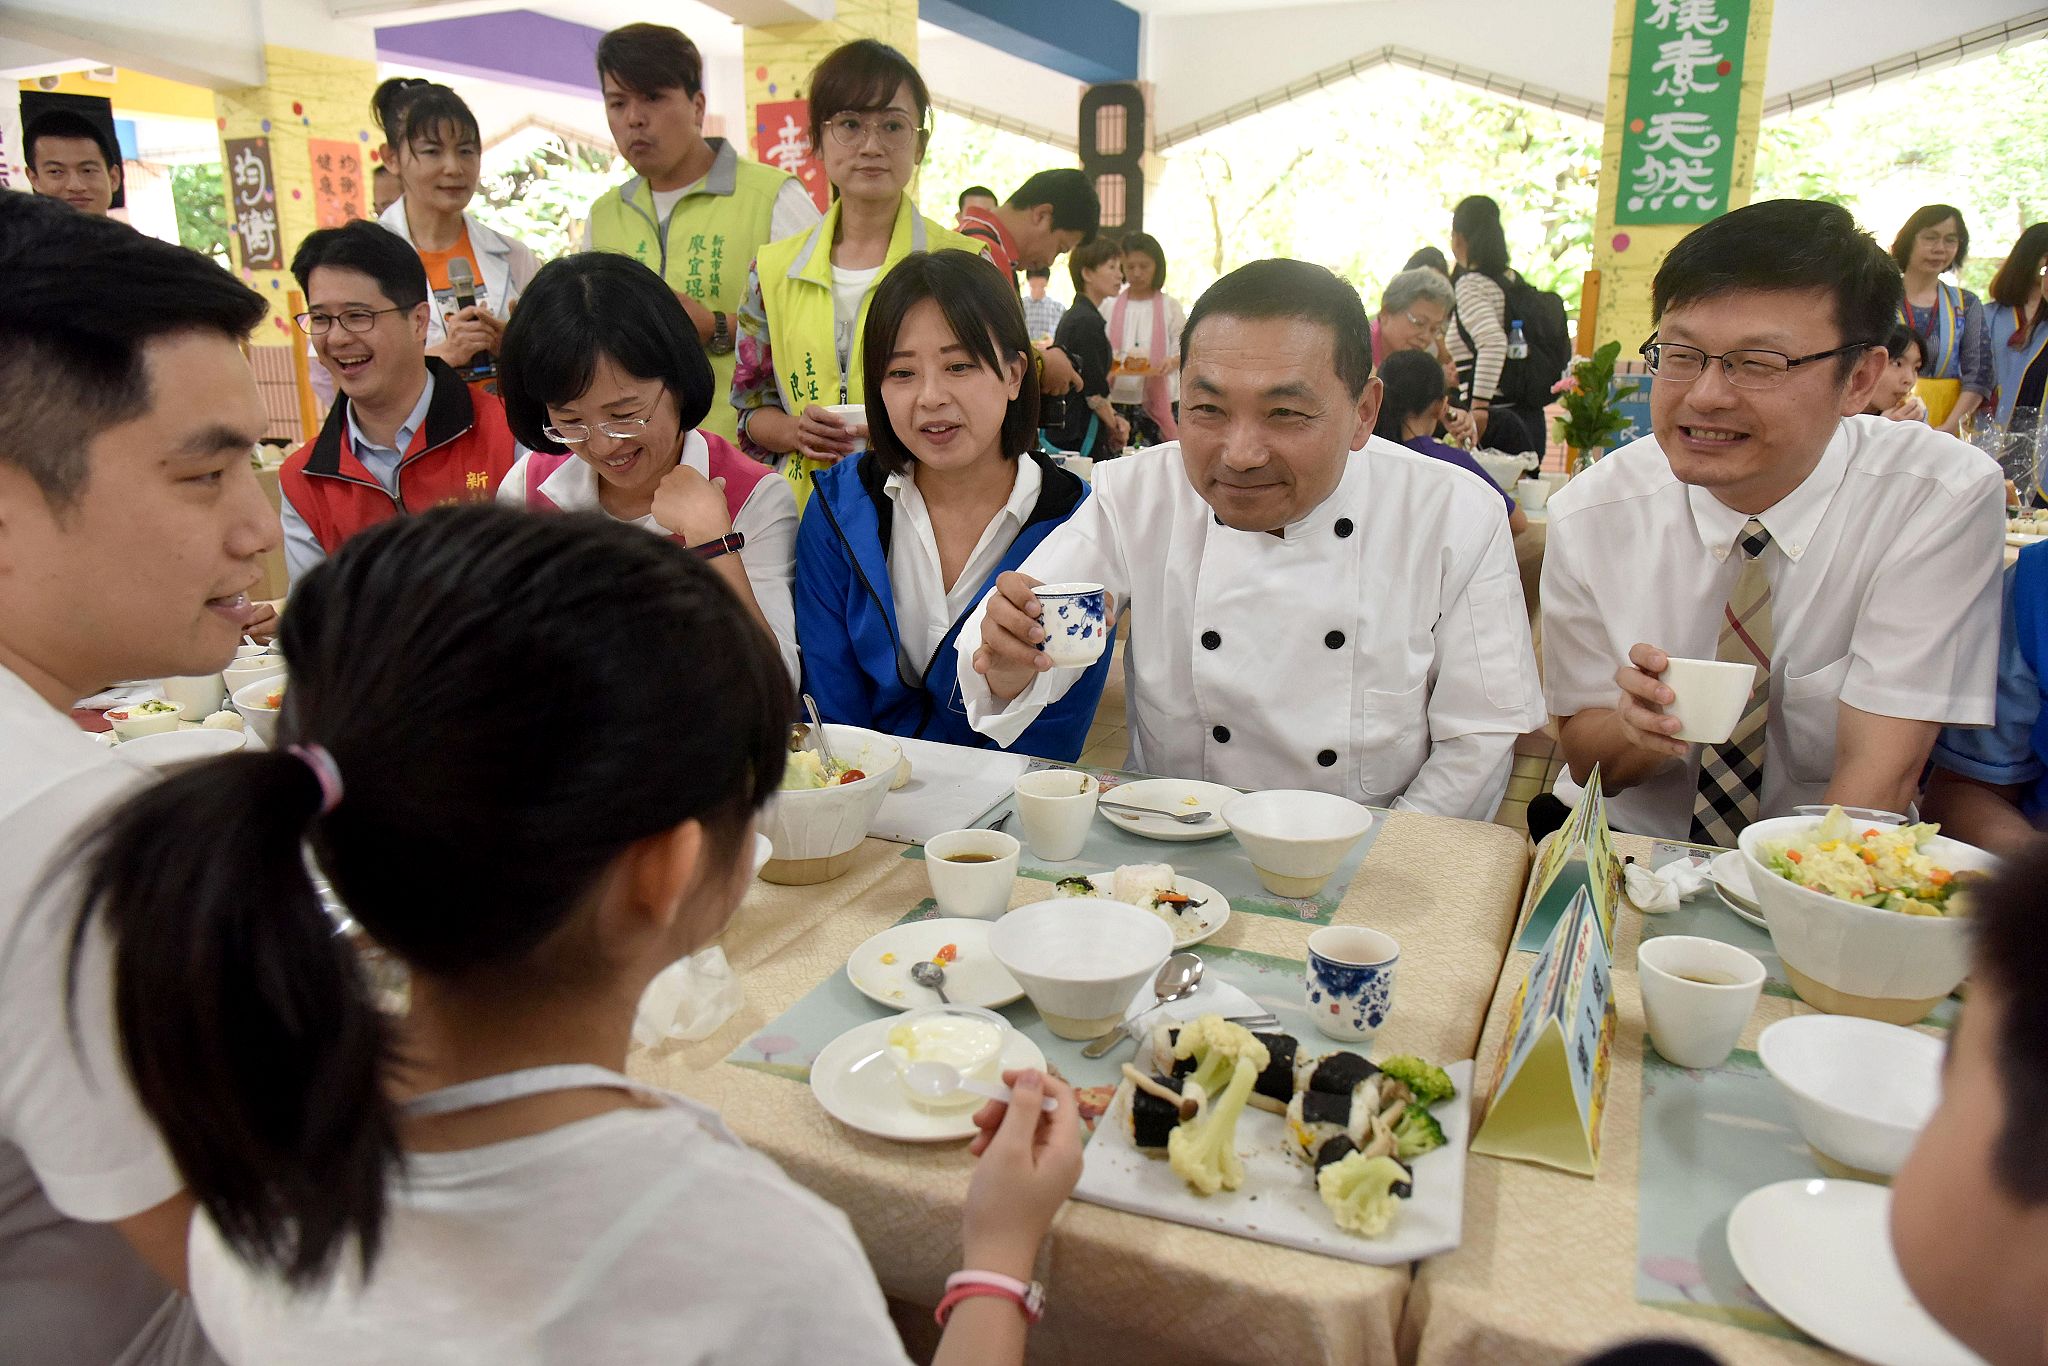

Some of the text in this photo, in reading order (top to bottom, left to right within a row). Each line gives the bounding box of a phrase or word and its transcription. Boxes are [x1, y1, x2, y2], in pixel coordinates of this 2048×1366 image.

[766, 114, 815, 192] 幸
[709, 234, 725, 298] 新北市議員
[804, 352, 819, 400] 主任
